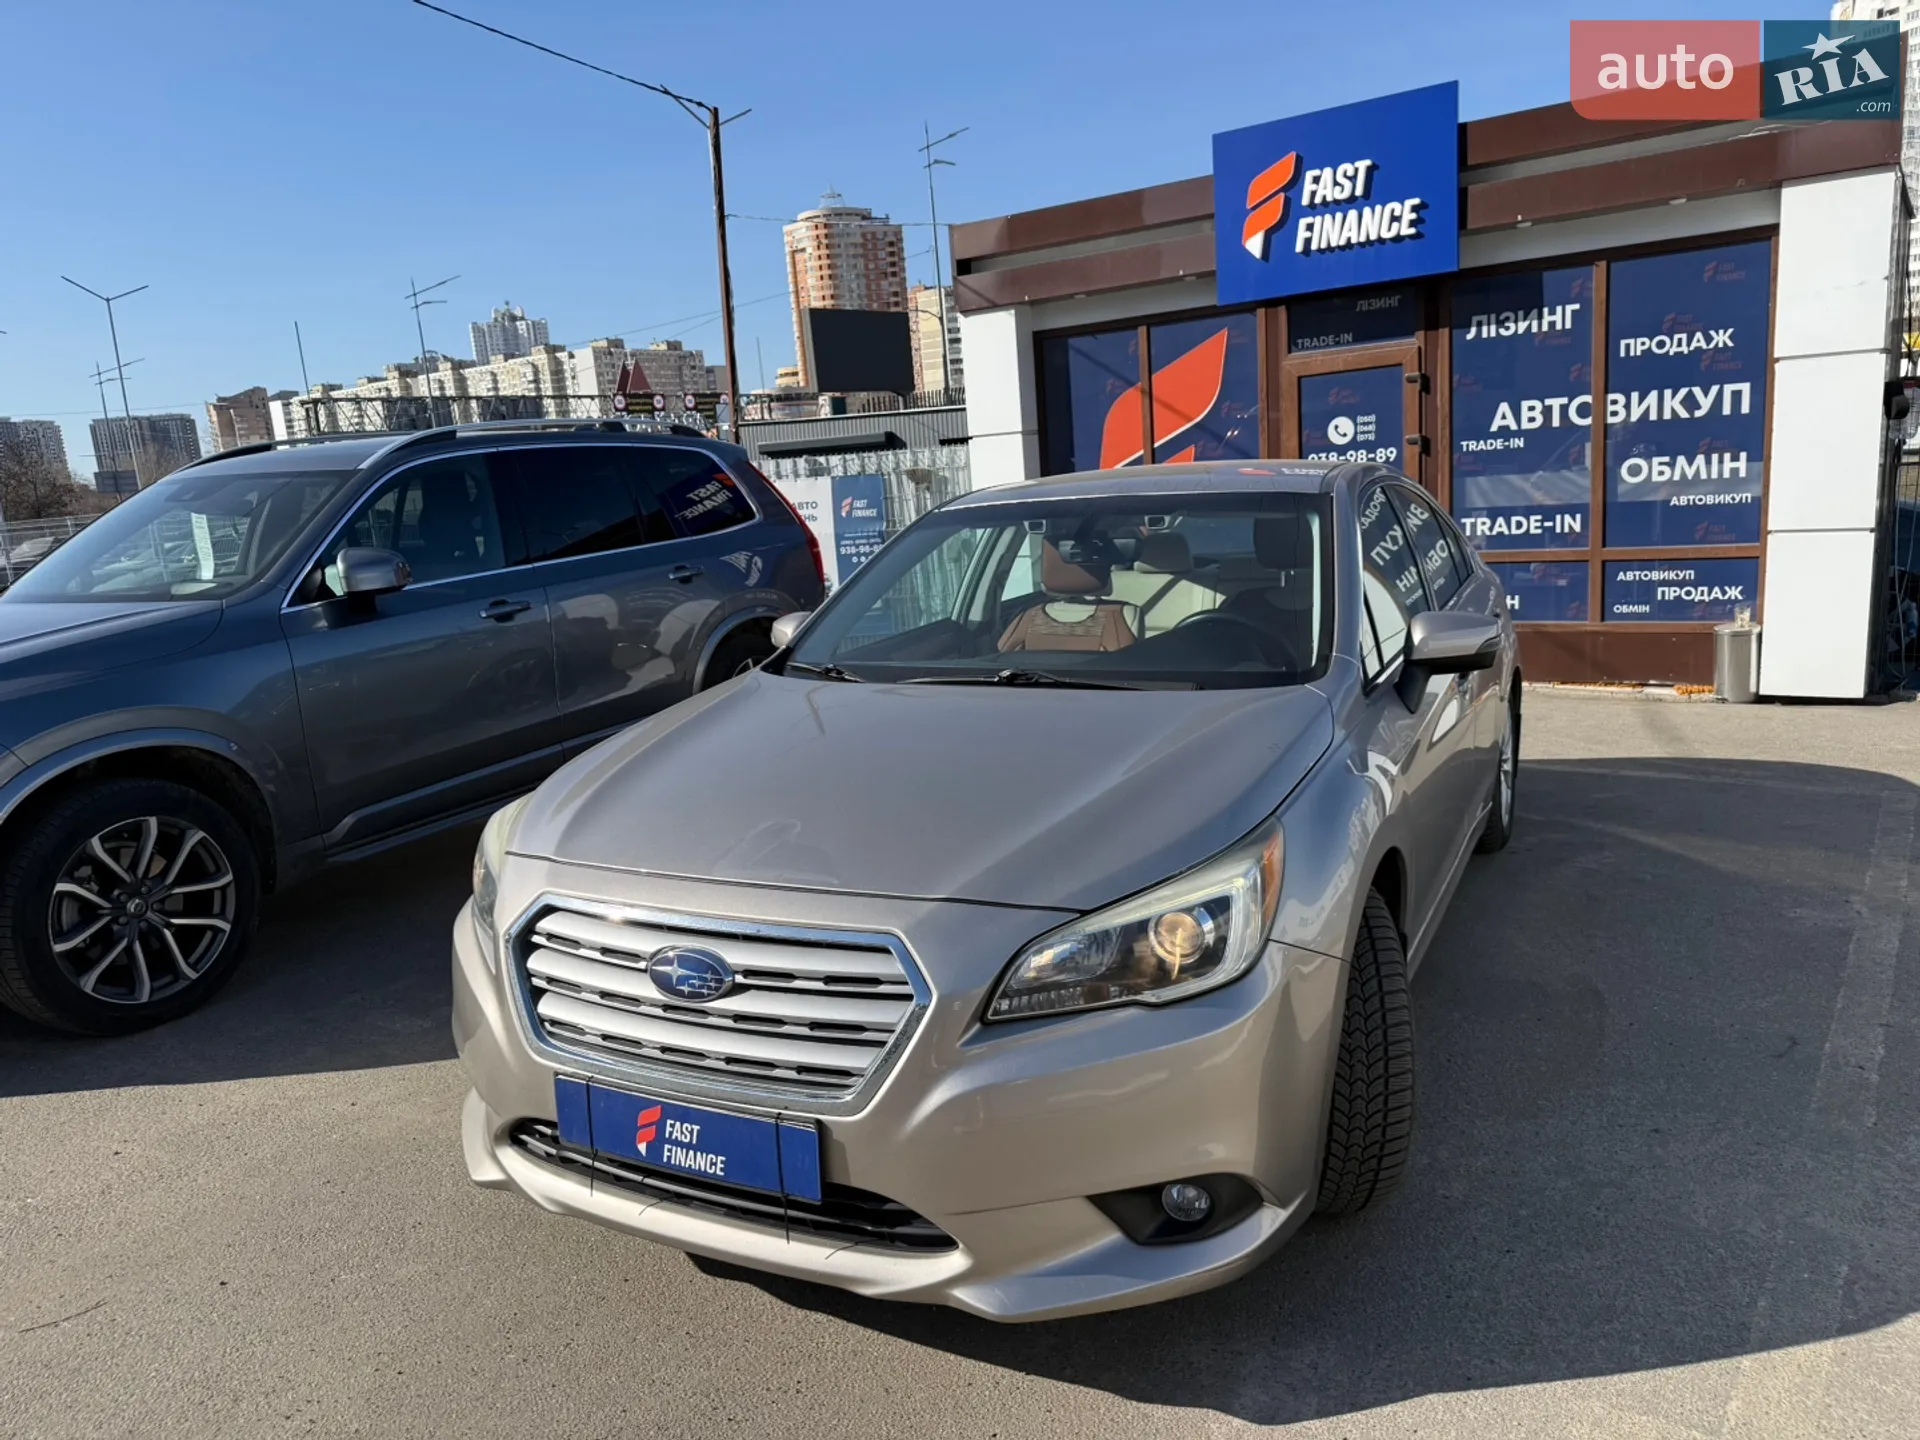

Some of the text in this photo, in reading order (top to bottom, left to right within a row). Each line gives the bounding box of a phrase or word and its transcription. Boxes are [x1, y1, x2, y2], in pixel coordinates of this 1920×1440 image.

[1301, 158, 1373, 206] FAST
[1294, 197, 1422, 253] FINANCE
[1355, 295, 1402, 312] ЛІЗИНГ
[1465, 302, 1581, 341] ЛІЗИНГ
[1296, 332, 1353, 349] TRADE-IN
[1619, 327, 1735, 357] ПРОДАЖ
[1489, 382, 1751, 432] АВТОВИКУП
[1460, 437, 1524, 452] TRADE-IN
[1620, 451, 1747, 484] ОБМІН
[1669, 492, 1752, 507] АВТОВИКУП
[1461, 513, 1581, 537] TRADE-IN
[1616, 569, 1695, 582] АВТОВИКУП
[1657, 585, 1743, 602] ПРОДАЖ
[1613, 604, 1650, 614] ОБМІН
[666, 1119, 700, 1144] FAST
[663, 1144, 726, 1176] FINANCE
